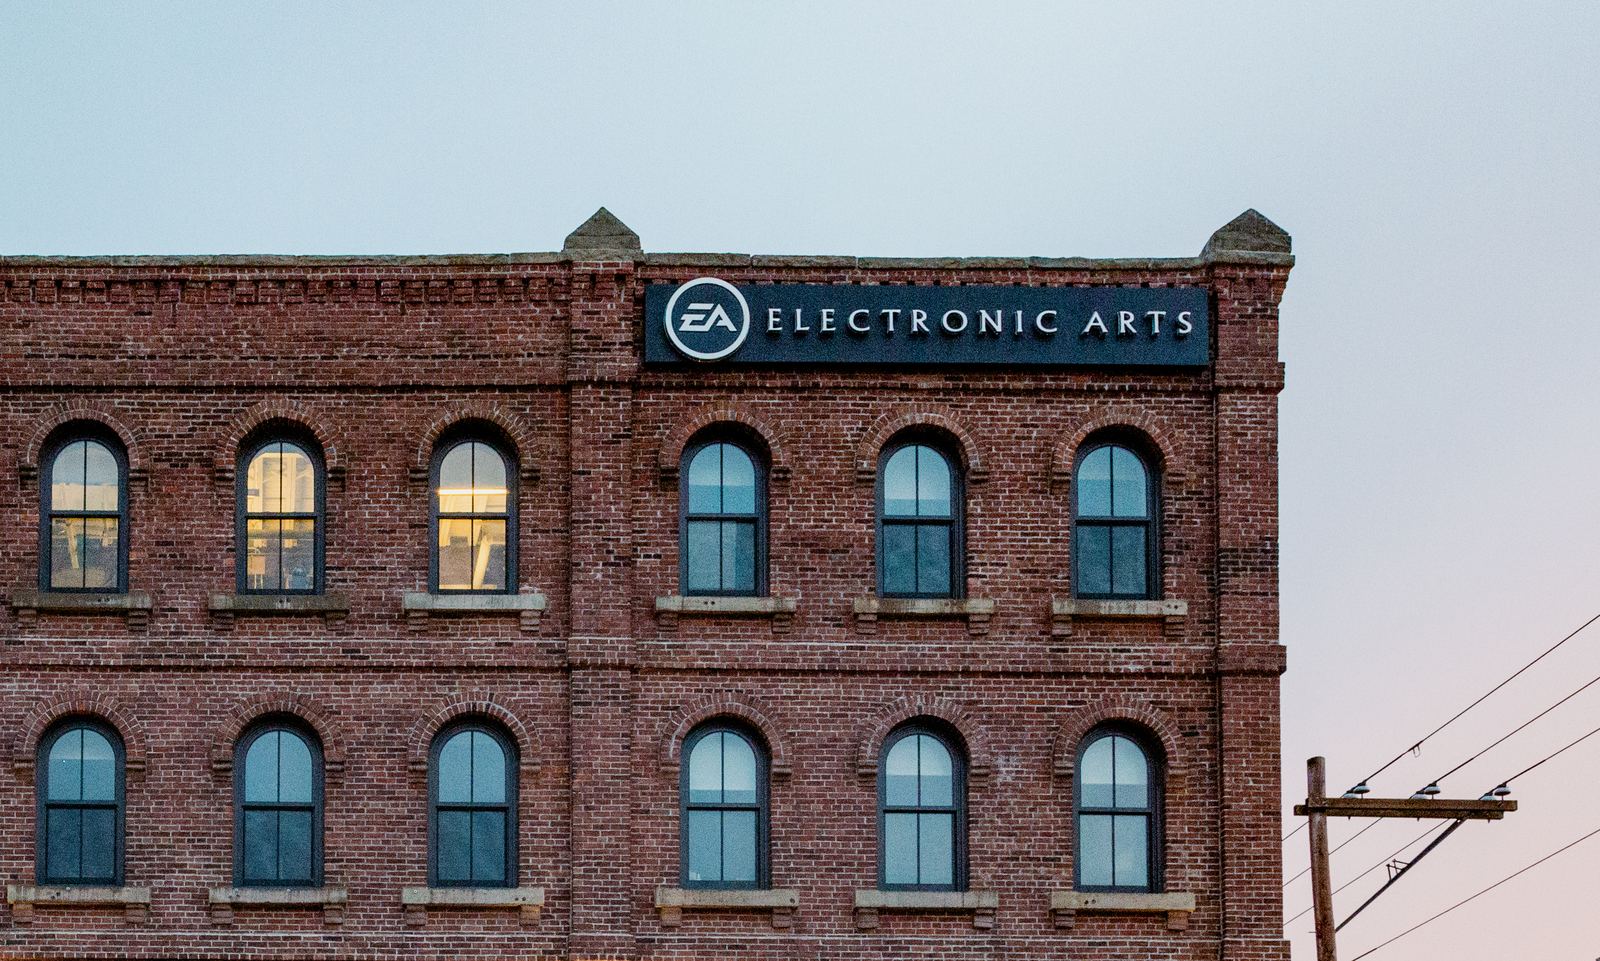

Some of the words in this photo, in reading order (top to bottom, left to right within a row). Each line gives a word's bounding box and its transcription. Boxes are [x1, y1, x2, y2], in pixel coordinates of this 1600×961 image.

[678, 302, 737, 333] EA
[767, 307, 1059, 335] ELECTRONIC
[1082, 309, 1194, 336] ARTS
